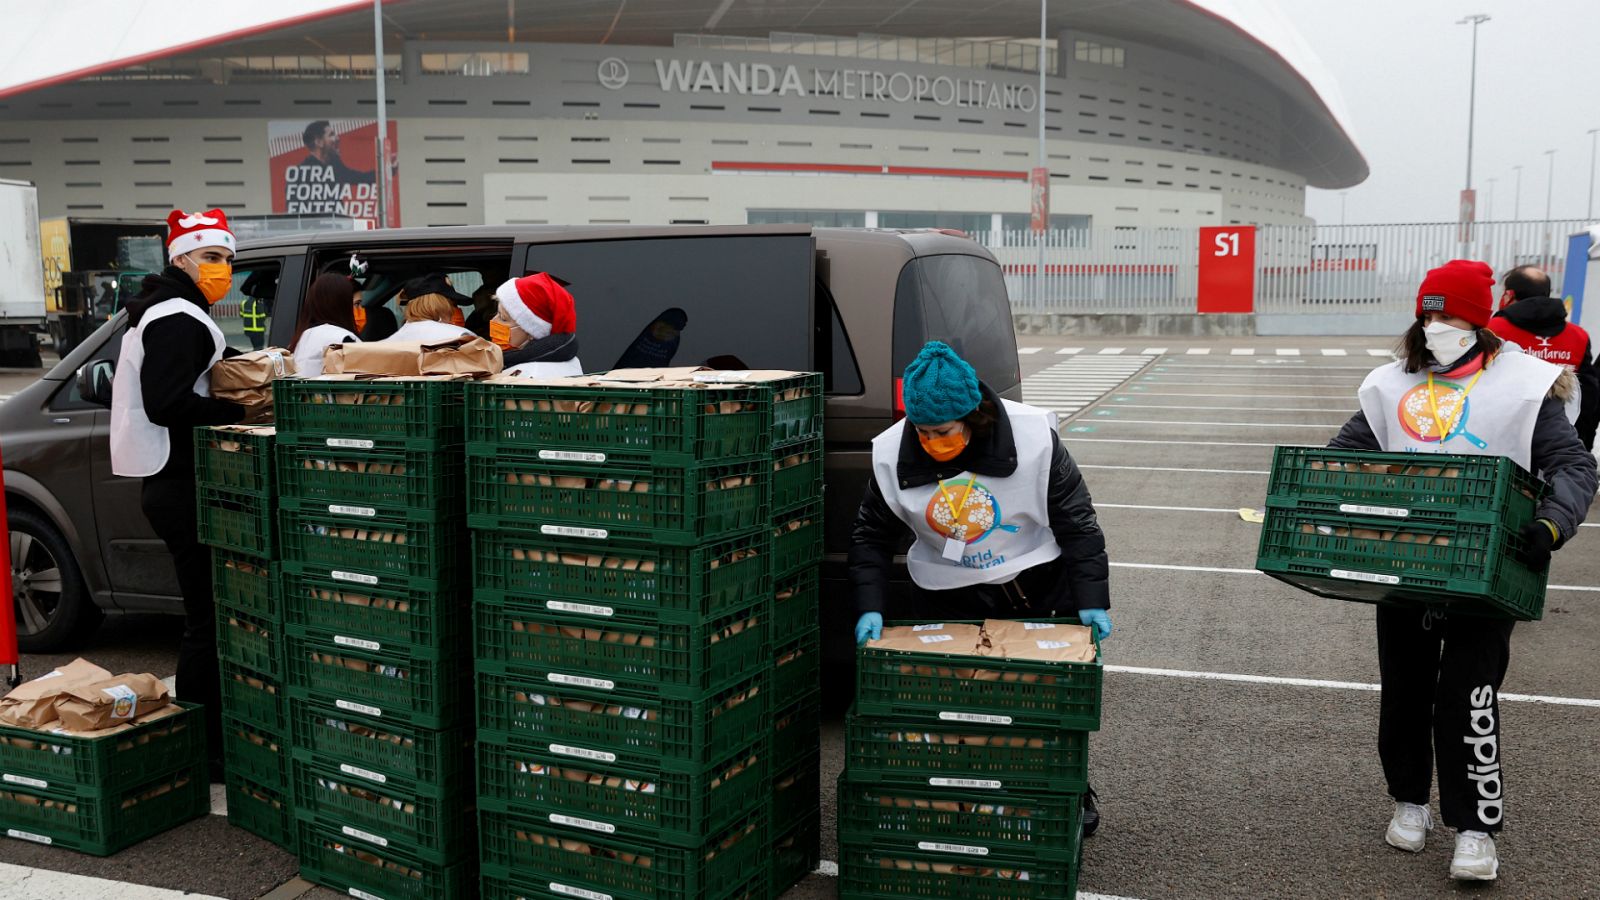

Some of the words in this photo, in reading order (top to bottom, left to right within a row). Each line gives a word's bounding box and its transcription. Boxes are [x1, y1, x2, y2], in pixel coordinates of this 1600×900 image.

[655, 59, 806, 97] WANDA
[814, 68, 1037, 113] METROPOLITANO
[285, 165, 335, 183] OTRA
[286, 183, 353, 201] FORMA
[288, 201, 379, 218] ENTENDE
[1214, 232, 1239, 256] S1
[1463, 684, 1502, 825] adidas
